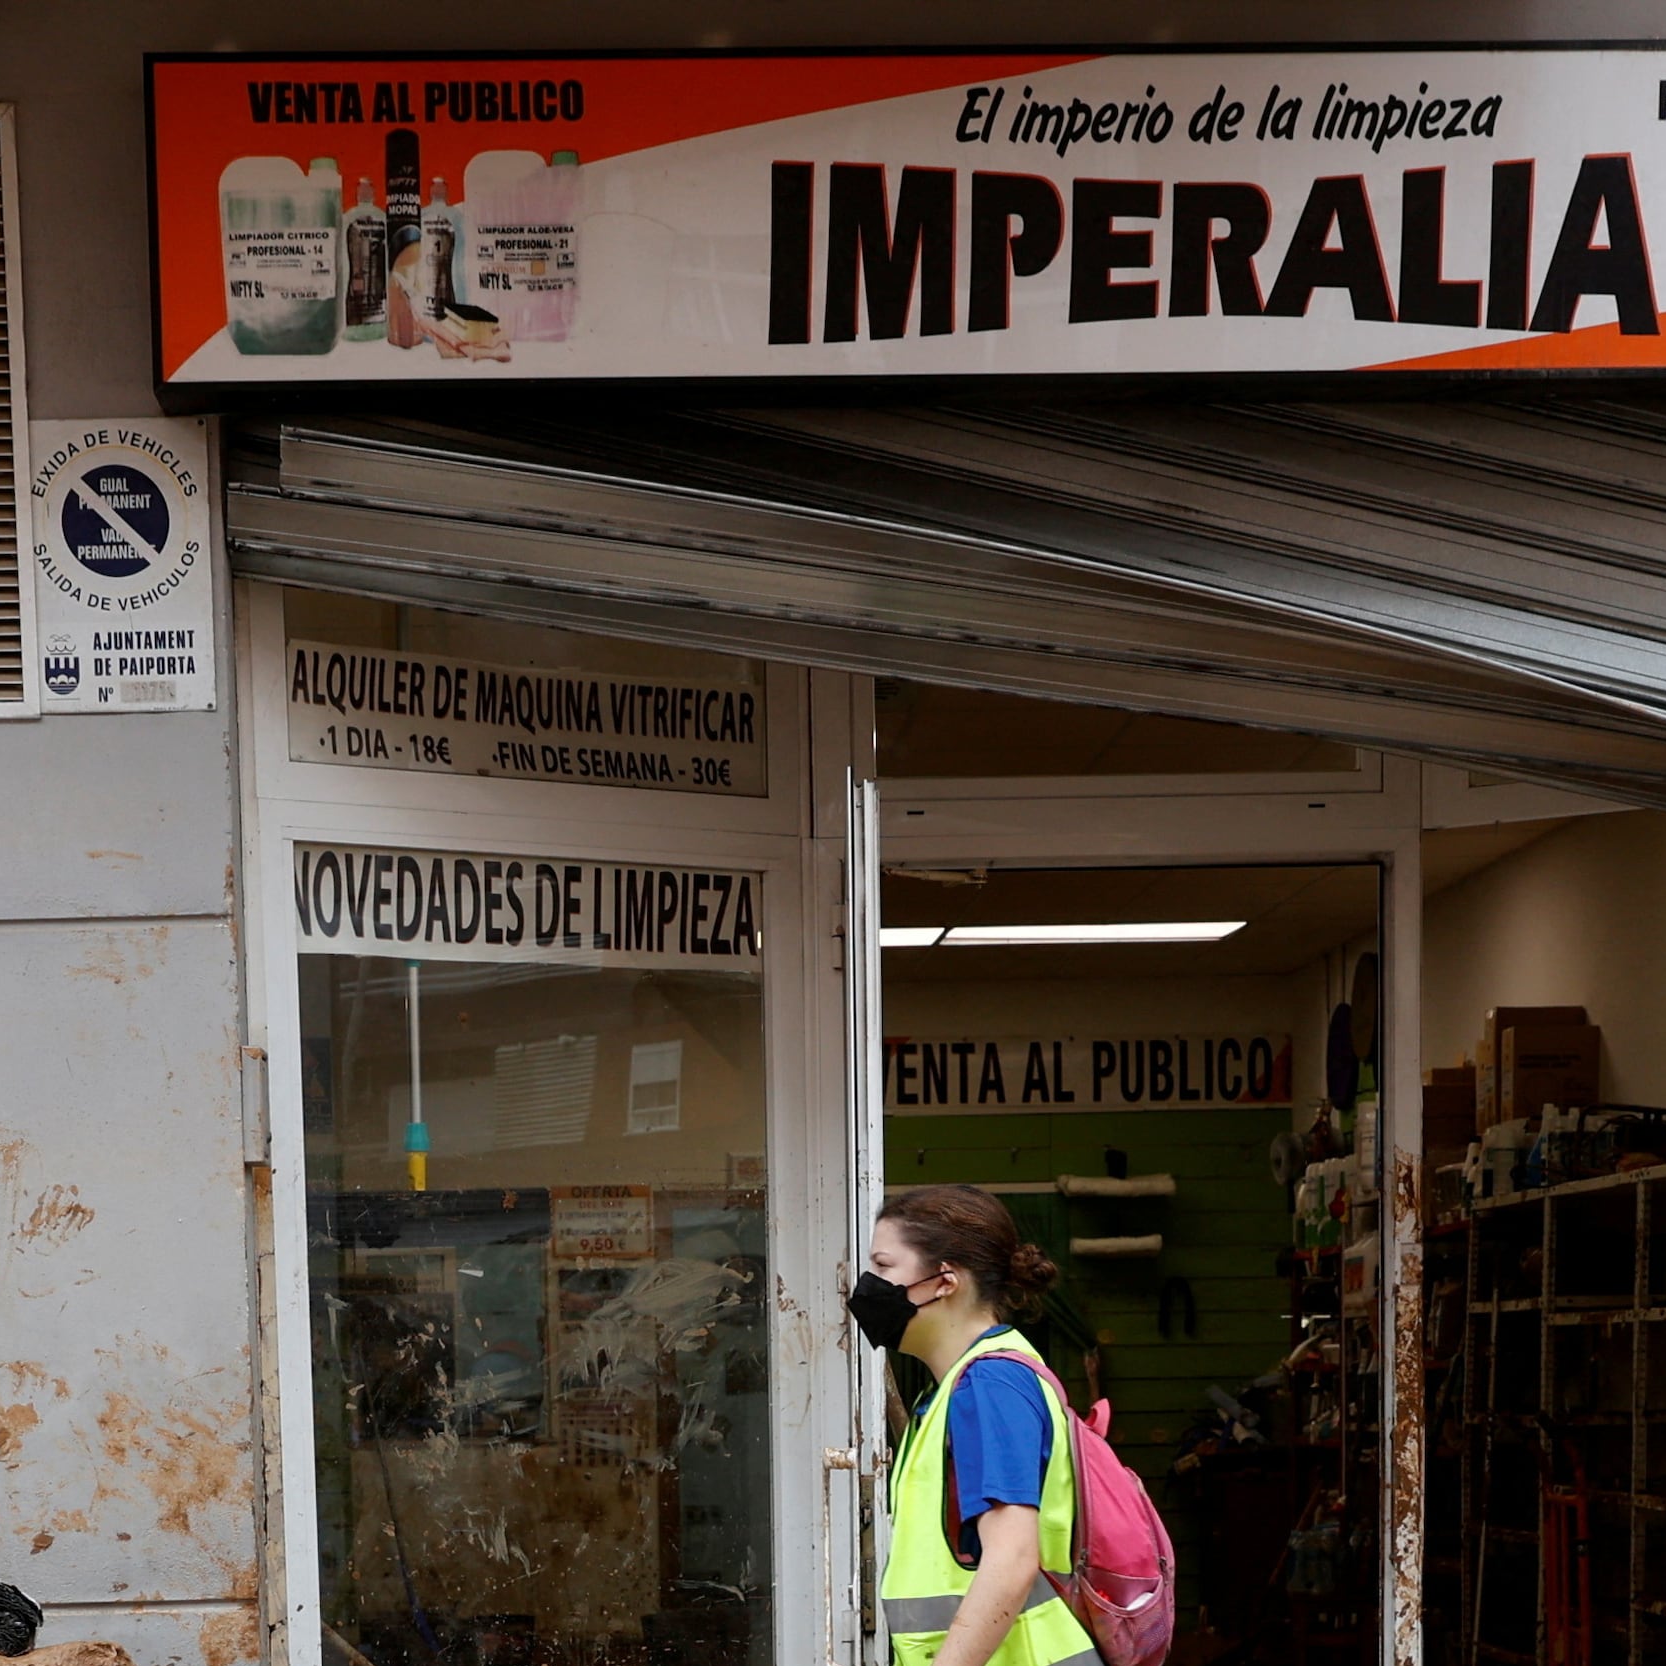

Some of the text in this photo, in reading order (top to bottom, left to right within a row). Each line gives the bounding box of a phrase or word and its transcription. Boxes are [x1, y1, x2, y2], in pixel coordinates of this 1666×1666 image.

[248, 80, 584, 123] VENTA AL PUBLICO
[955, 82, 1503, 157] El imperio de la limpieza
[229, 231, 329, 241] LIMPIADOR CITRICO
[478, 226, 525, 235] LIMPIADOR
[495, 239, 552, 249] PROFESIONAL
[247, 246, 306, 256] PROFESIONAL
[313, 245, 323, 254] 14
[768, 152, 1661, 345] IMPERALIA
[230, 280, 252, 298] NIFTY
[254, 281, 264, 298] SL
[479, 273, 500, 289] NIFTY
[502, 273, 512, 290] SL
[31, 430, 198, 498] EIXIDA DE VEHICLES
[100, 478, 130, 492] GUAL
[34, 541, 200, 611] SALIDA DE VEHICULOS
[93, 630, 194, 651] AJUNTAMENT
[94, 656, 195, 676] DE PAIPORTA
[292, 649, 754, 743] ALQUILER DE MAQUINA VITRIFICAR
[347, 726, 389, 759] DIA
[409, 734, 452, 764] 18€
[497, 742, 537, 772] FIN
[542, 746, 573, 775] DE
[579, 748, 674, 782] SEMANA
[693, 757, 732, 786] 30€
[535, 863, 582, 947] DE
[595, 867, 758, 956] LIMPIEZA
[1022, 1042, 1074, 1105] AL
[1092, 1037, 1273, 1104] PUBLICO
[571, 1185, 632, 1198] OFERTA
